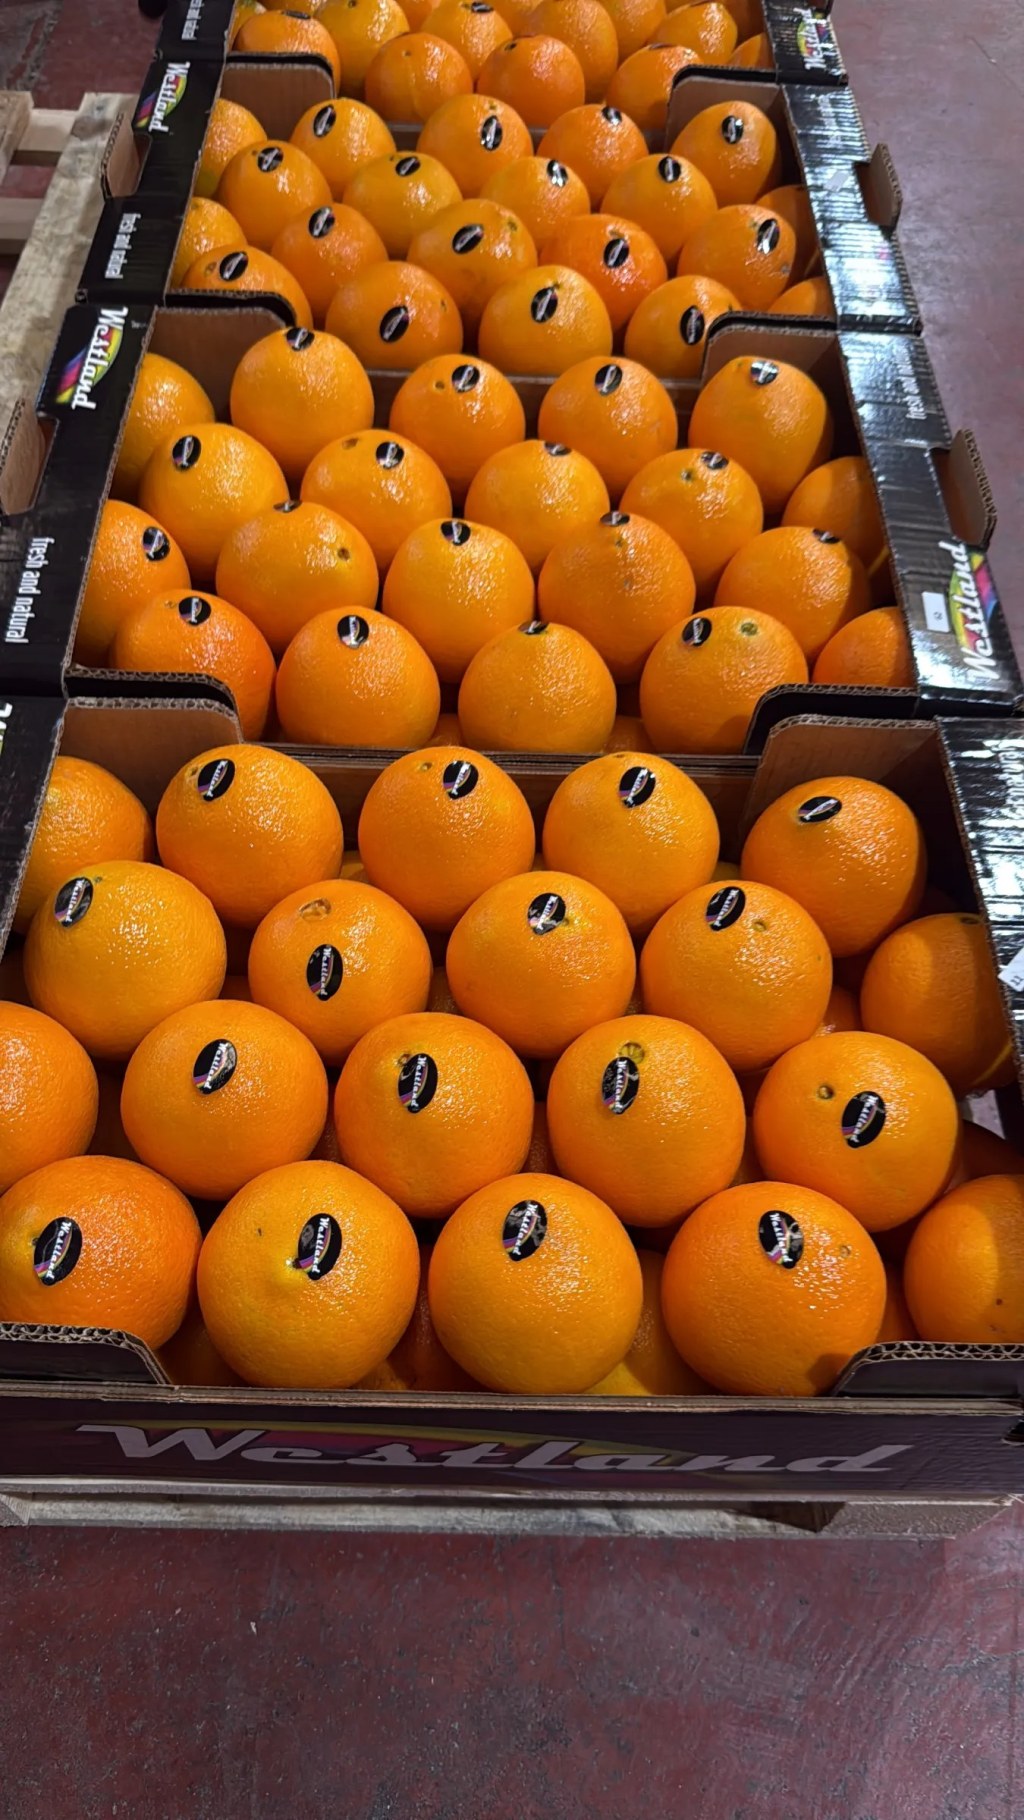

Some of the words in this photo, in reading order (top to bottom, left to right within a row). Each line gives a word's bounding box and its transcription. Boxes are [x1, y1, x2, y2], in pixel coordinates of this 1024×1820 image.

[149, 61, 191, 133] Westland
[72, 306, 129, 410] Westland
[25, 537, 55, 568] fresh
[18, 570, 41, 594] and
[938, 536, 1000, 681] Westland
[5, 597, 35, 643] natural
[45, 1221, 72, 1278] Westland
[312, 1217, 330, 1274] Westland
[769, 1212, 793, 1263] Westland
[75, 1424, 914, 1472] Westland
